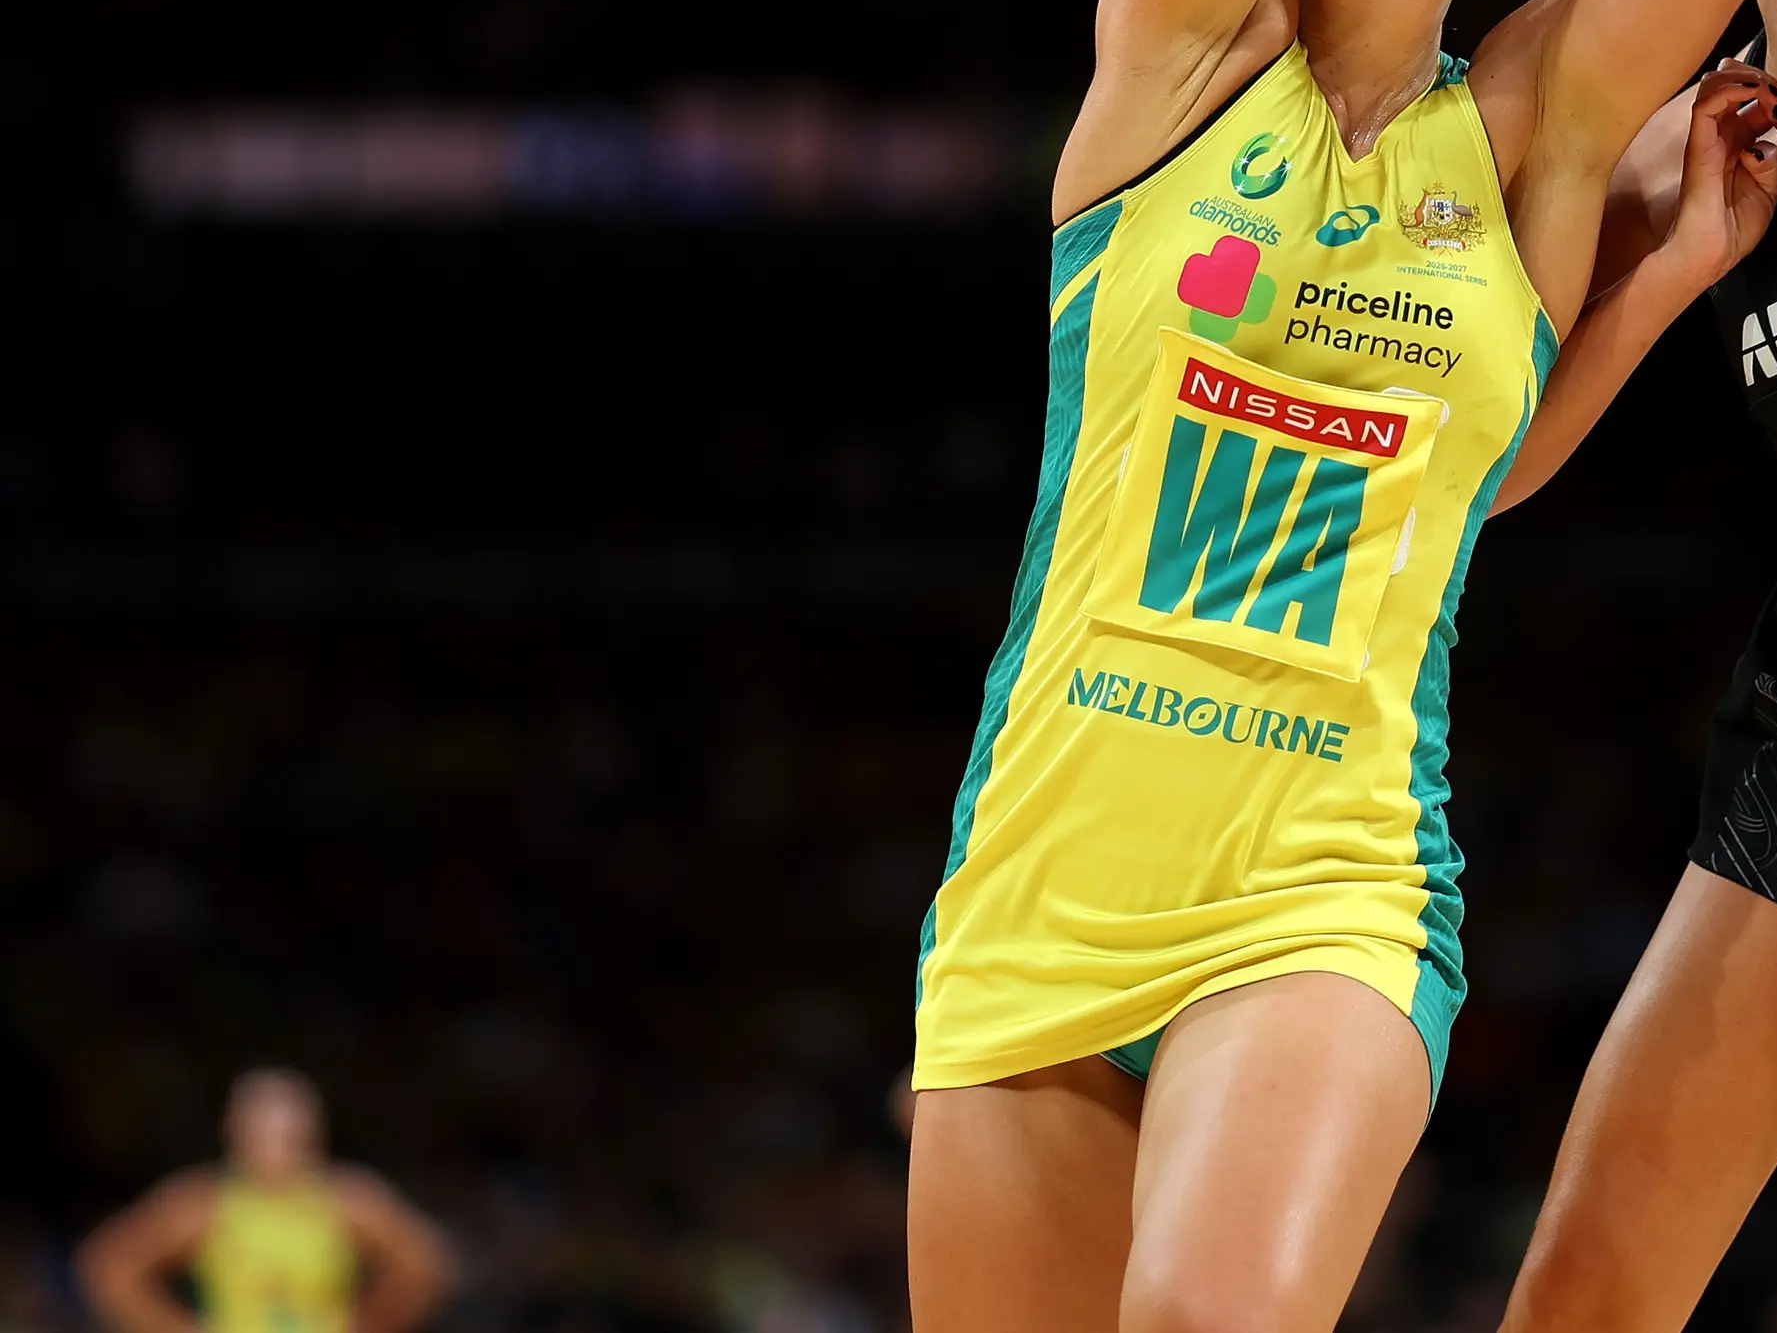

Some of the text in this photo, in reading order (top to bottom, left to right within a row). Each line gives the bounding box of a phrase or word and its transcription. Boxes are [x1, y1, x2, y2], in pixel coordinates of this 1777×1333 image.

[1209, 195, 1274, 227] AUSTRALIAN
[1294, 280, 1454, 331] priceline
[1396, 266, 1488, 287] INTERNATIONAL SERIES
[1284, 315, 1463, 378] pharmacy
[1189, 370, 1395, 449] NISSAN
[1138, 414, 1369, 646] WA
[1068, 668, 1350, 762] MELBOURNE
